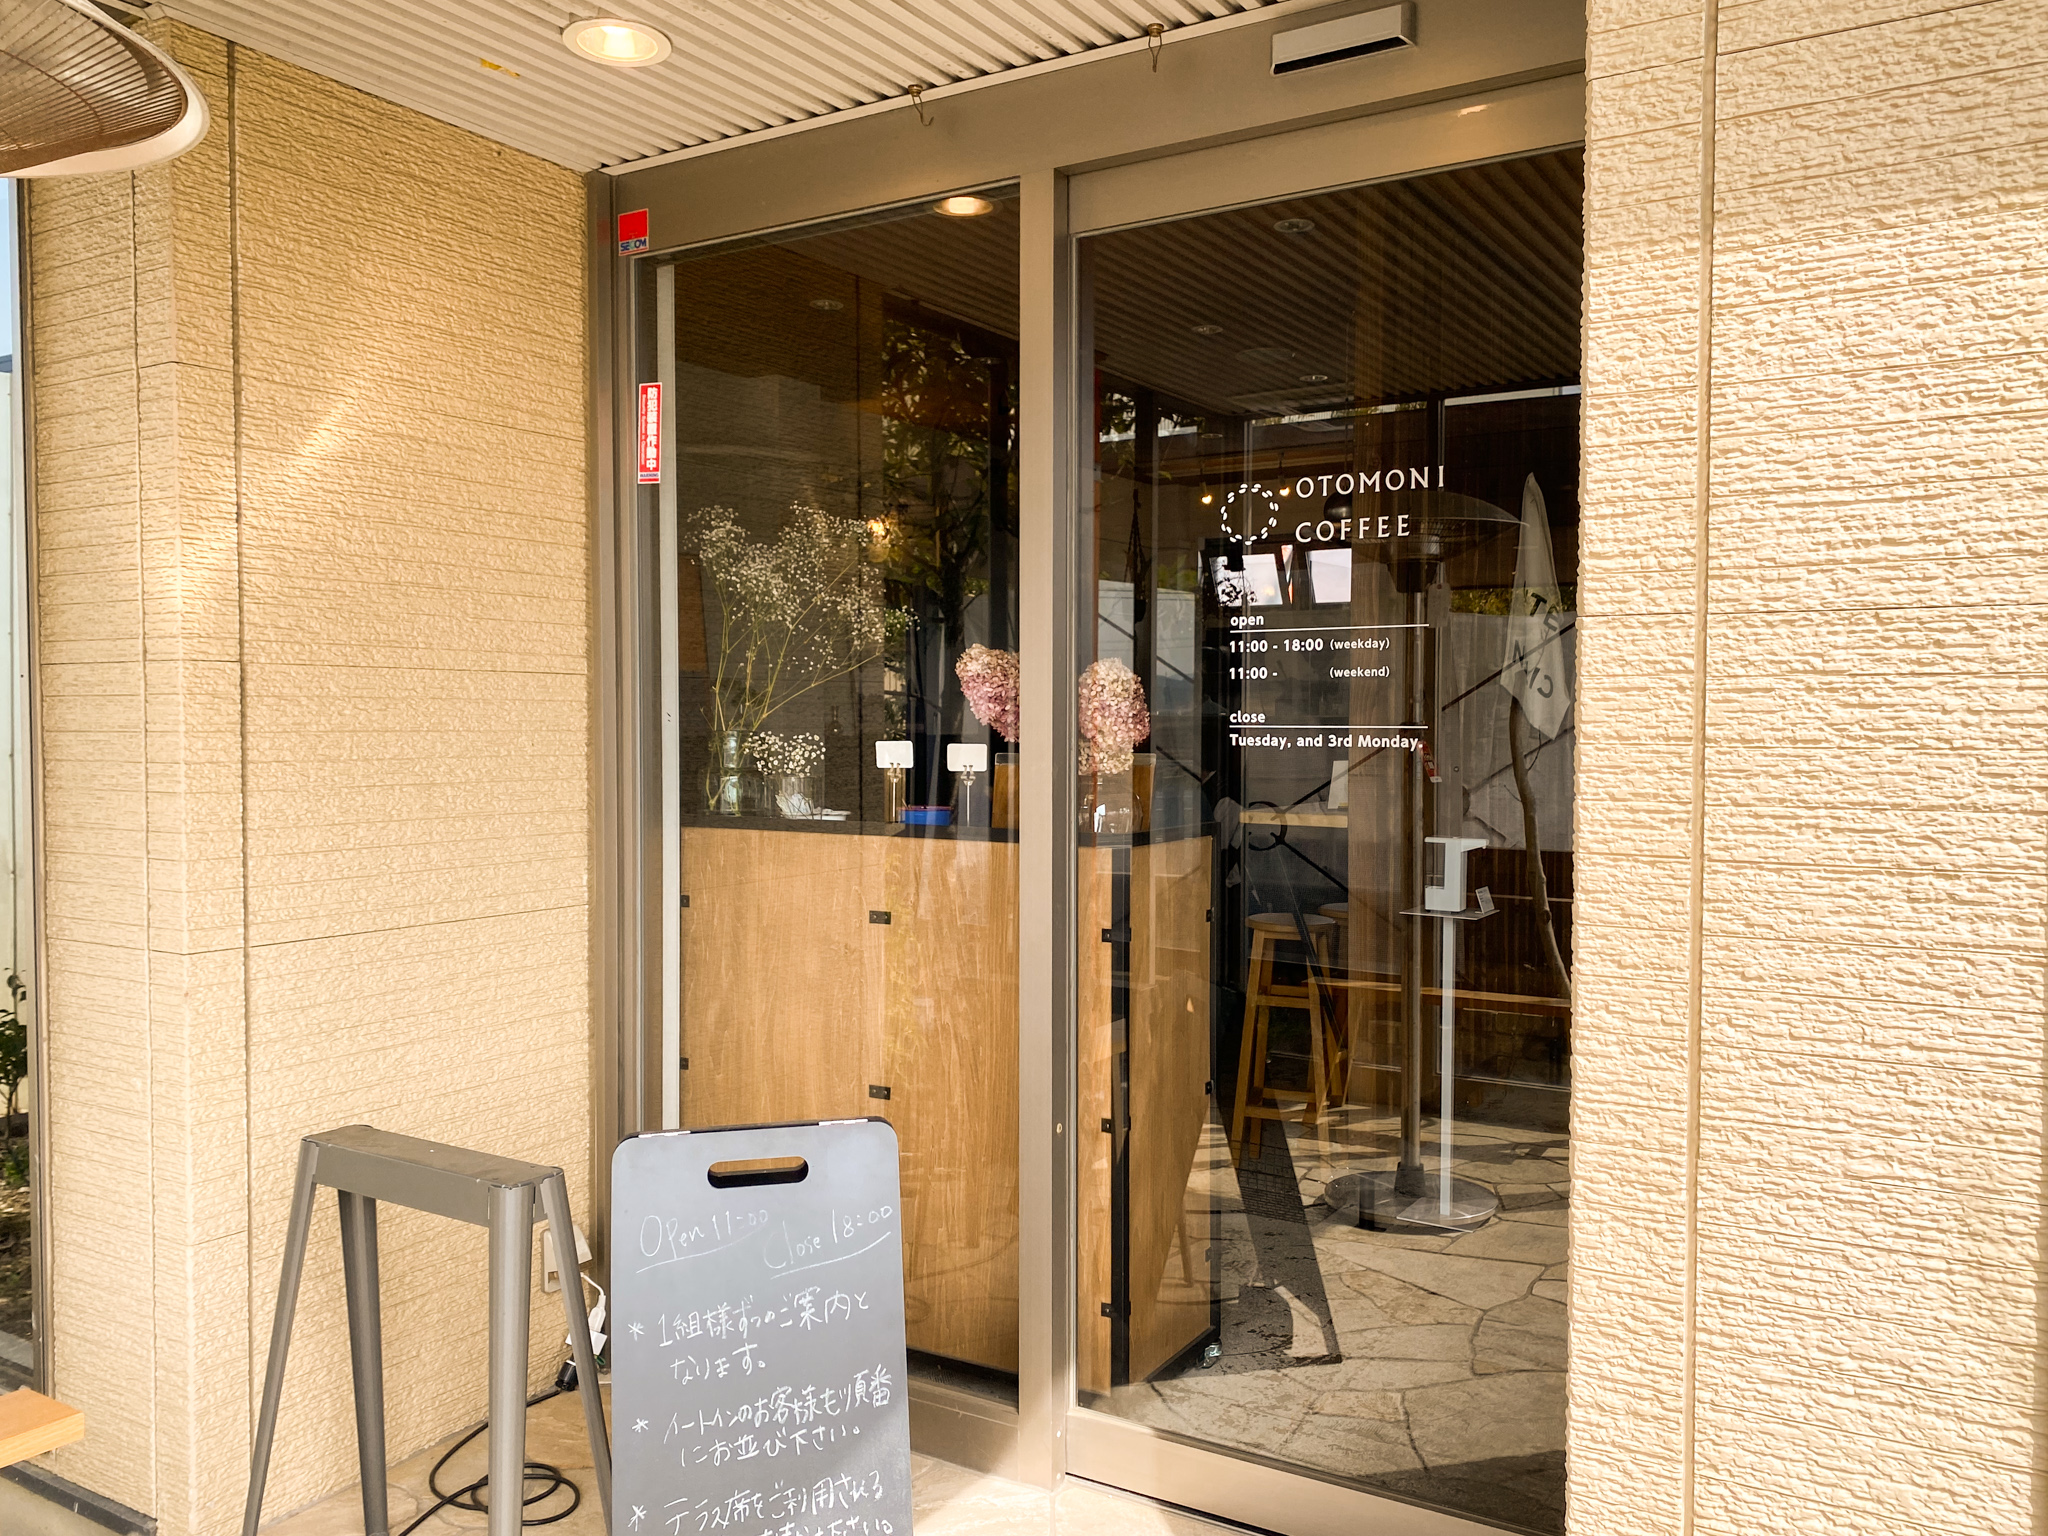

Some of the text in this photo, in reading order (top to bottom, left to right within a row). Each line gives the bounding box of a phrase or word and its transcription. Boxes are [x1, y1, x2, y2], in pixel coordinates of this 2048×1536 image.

[620, 237, 647, 252] SECOM
[1295, 465, 1445, 499] OTOMONI
[1295, 514, 1410, 543] COFFEE
[1230, 615, 1264, 630] open
[1229, 639, 1268, 653] 11:00
[1283, 638, 1324, 652] 18:00
[1330, 637, 1390, 651] (weekday)
[1229, 666, 1268, 680] 11:00
[1329, 666, 1390, 679] (weekend)
[1229, 710, 1266, 723] close
[1229, 733, 1424, 752] Tuesday, and 3rd Monday.
[831, 1205, 893, 1244] 18:00
